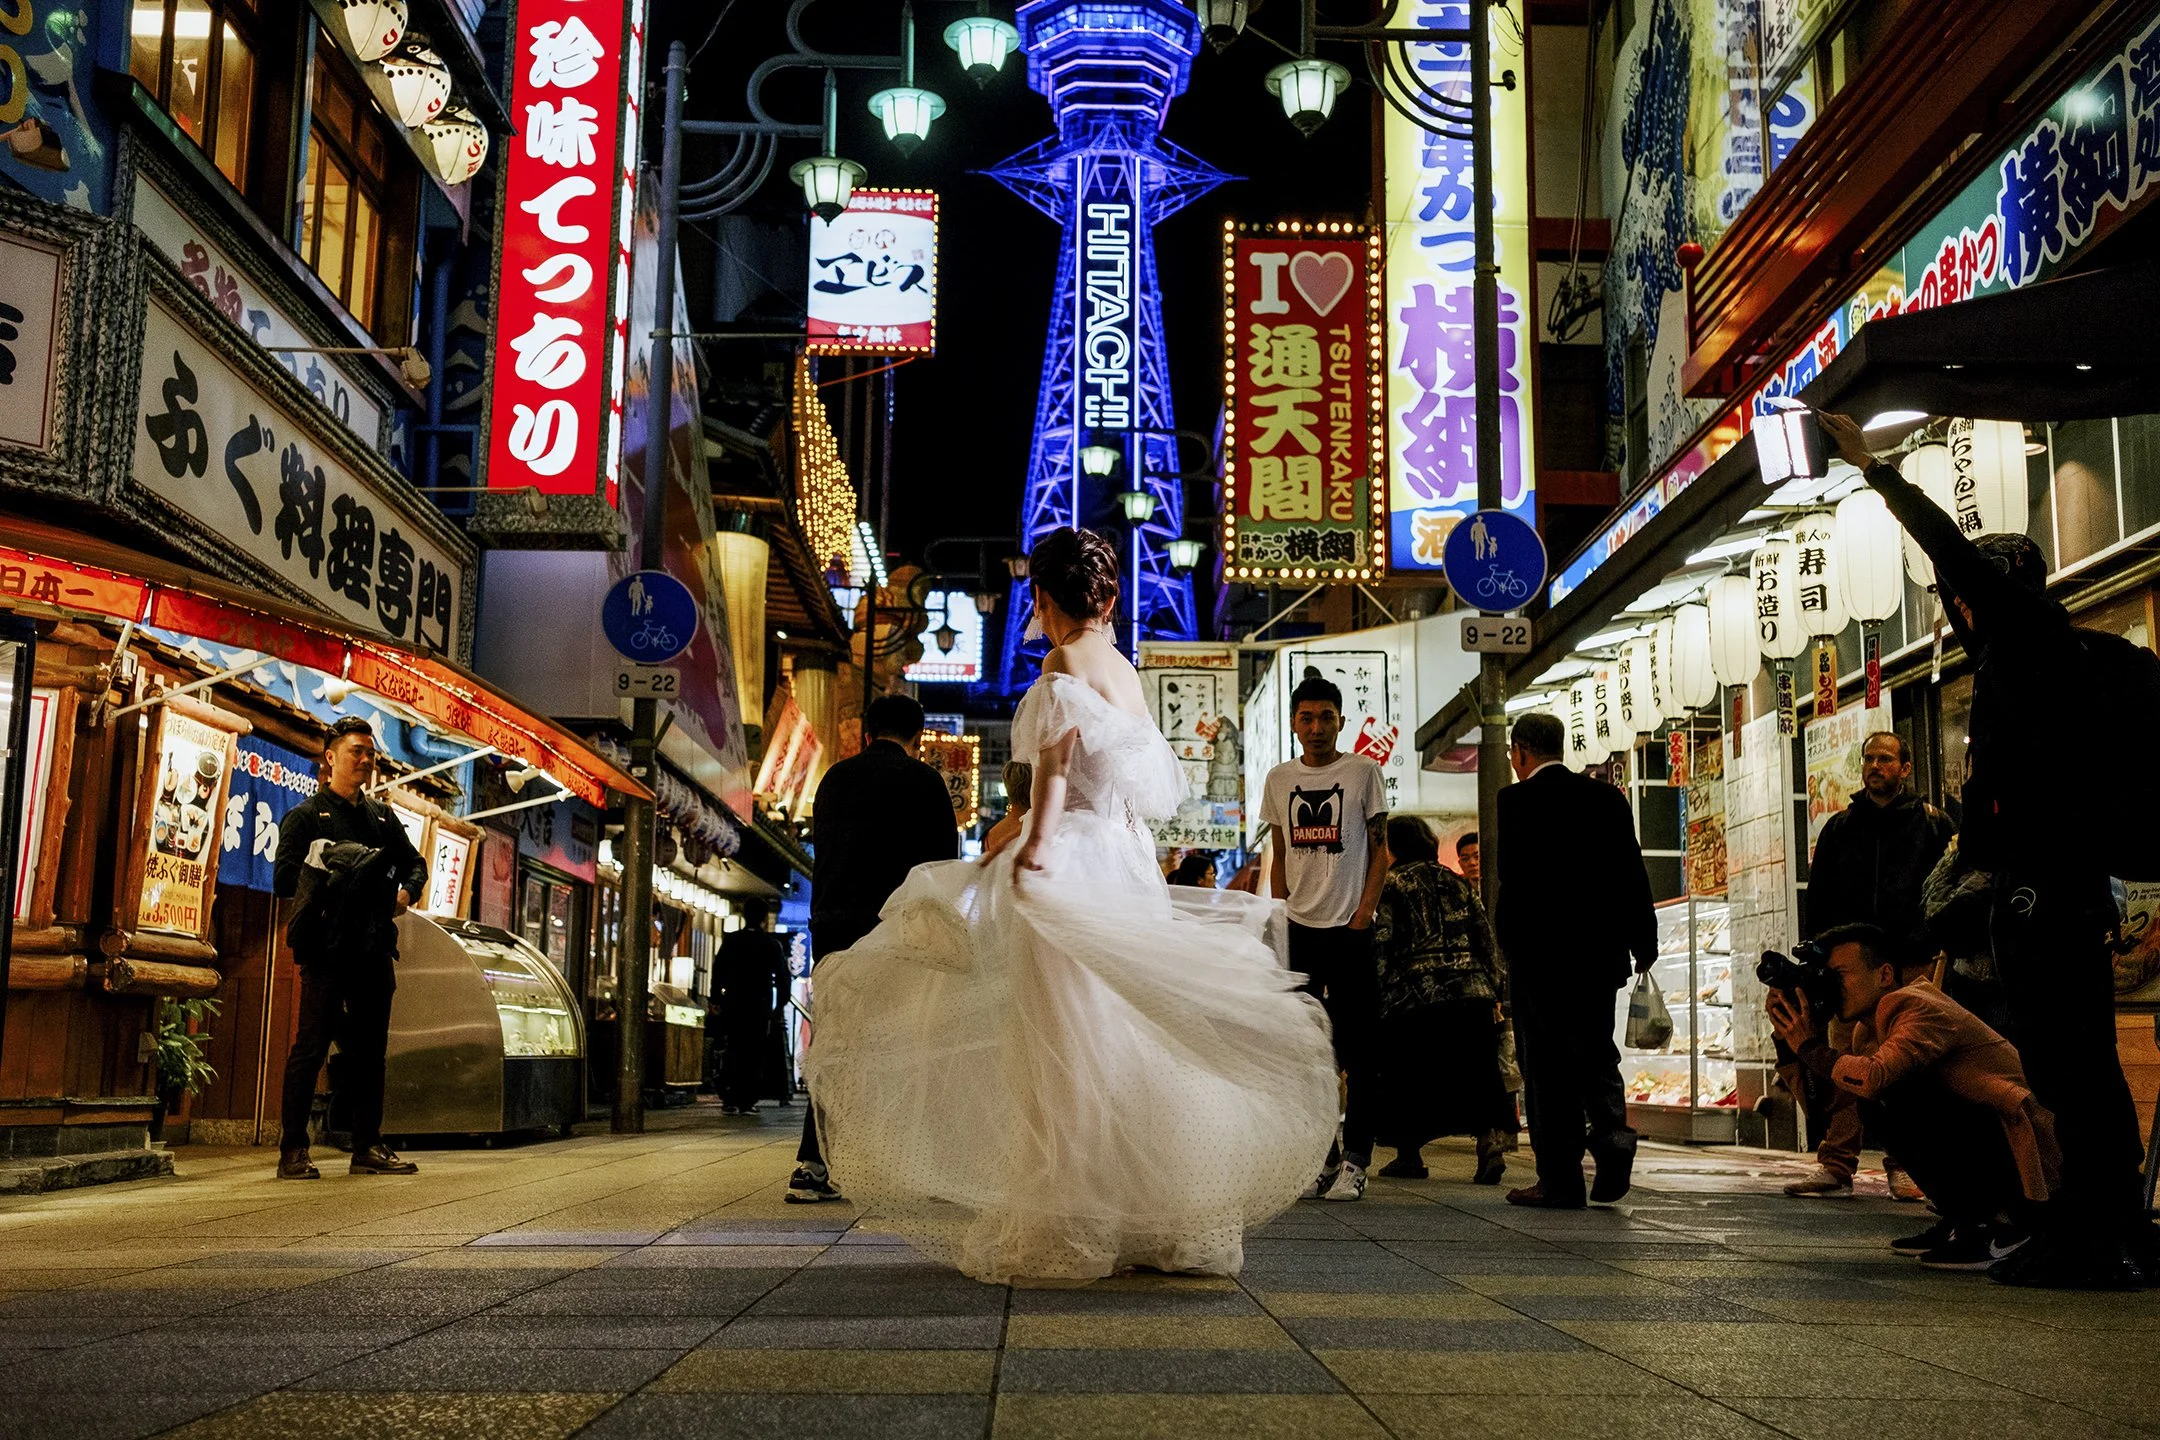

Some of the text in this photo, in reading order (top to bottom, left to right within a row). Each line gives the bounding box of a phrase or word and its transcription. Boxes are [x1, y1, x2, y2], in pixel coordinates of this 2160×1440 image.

[507, 16, 605, 477] 珍味てっちり
[1086, 203, 1130, 428] HITACHI
[1249, 252, 1290, 315] I
[1248, 323, 1323, 522] 通天閣
[1328, 324, 1352, 521] TSUTENKAKU
[1400, 284, 1522, 501] 横綱
[145, 350, 452, 656] ふぐ料理専門
[1951, 436, 1984, 534] ちゃんこ鍋
[1240, 534, 1284, 545] 日本一の
[1240, 547, 1283, 561] 串かつ
[1284, 528, 1356, 563] 横綱
[1796, 529, 1831, 544] 職人の
[1756, 569, 1780, 643] お造り
[1798, 547, 1828, 612] 寿司
[1594, 683, 1611, 738] もつ鍋
[1293, 826, 1339, 842] PANCOAT
[145, 852, 203, 889] 焼ふぐ御膳
[152, 902, 197, 930] 3,500円
